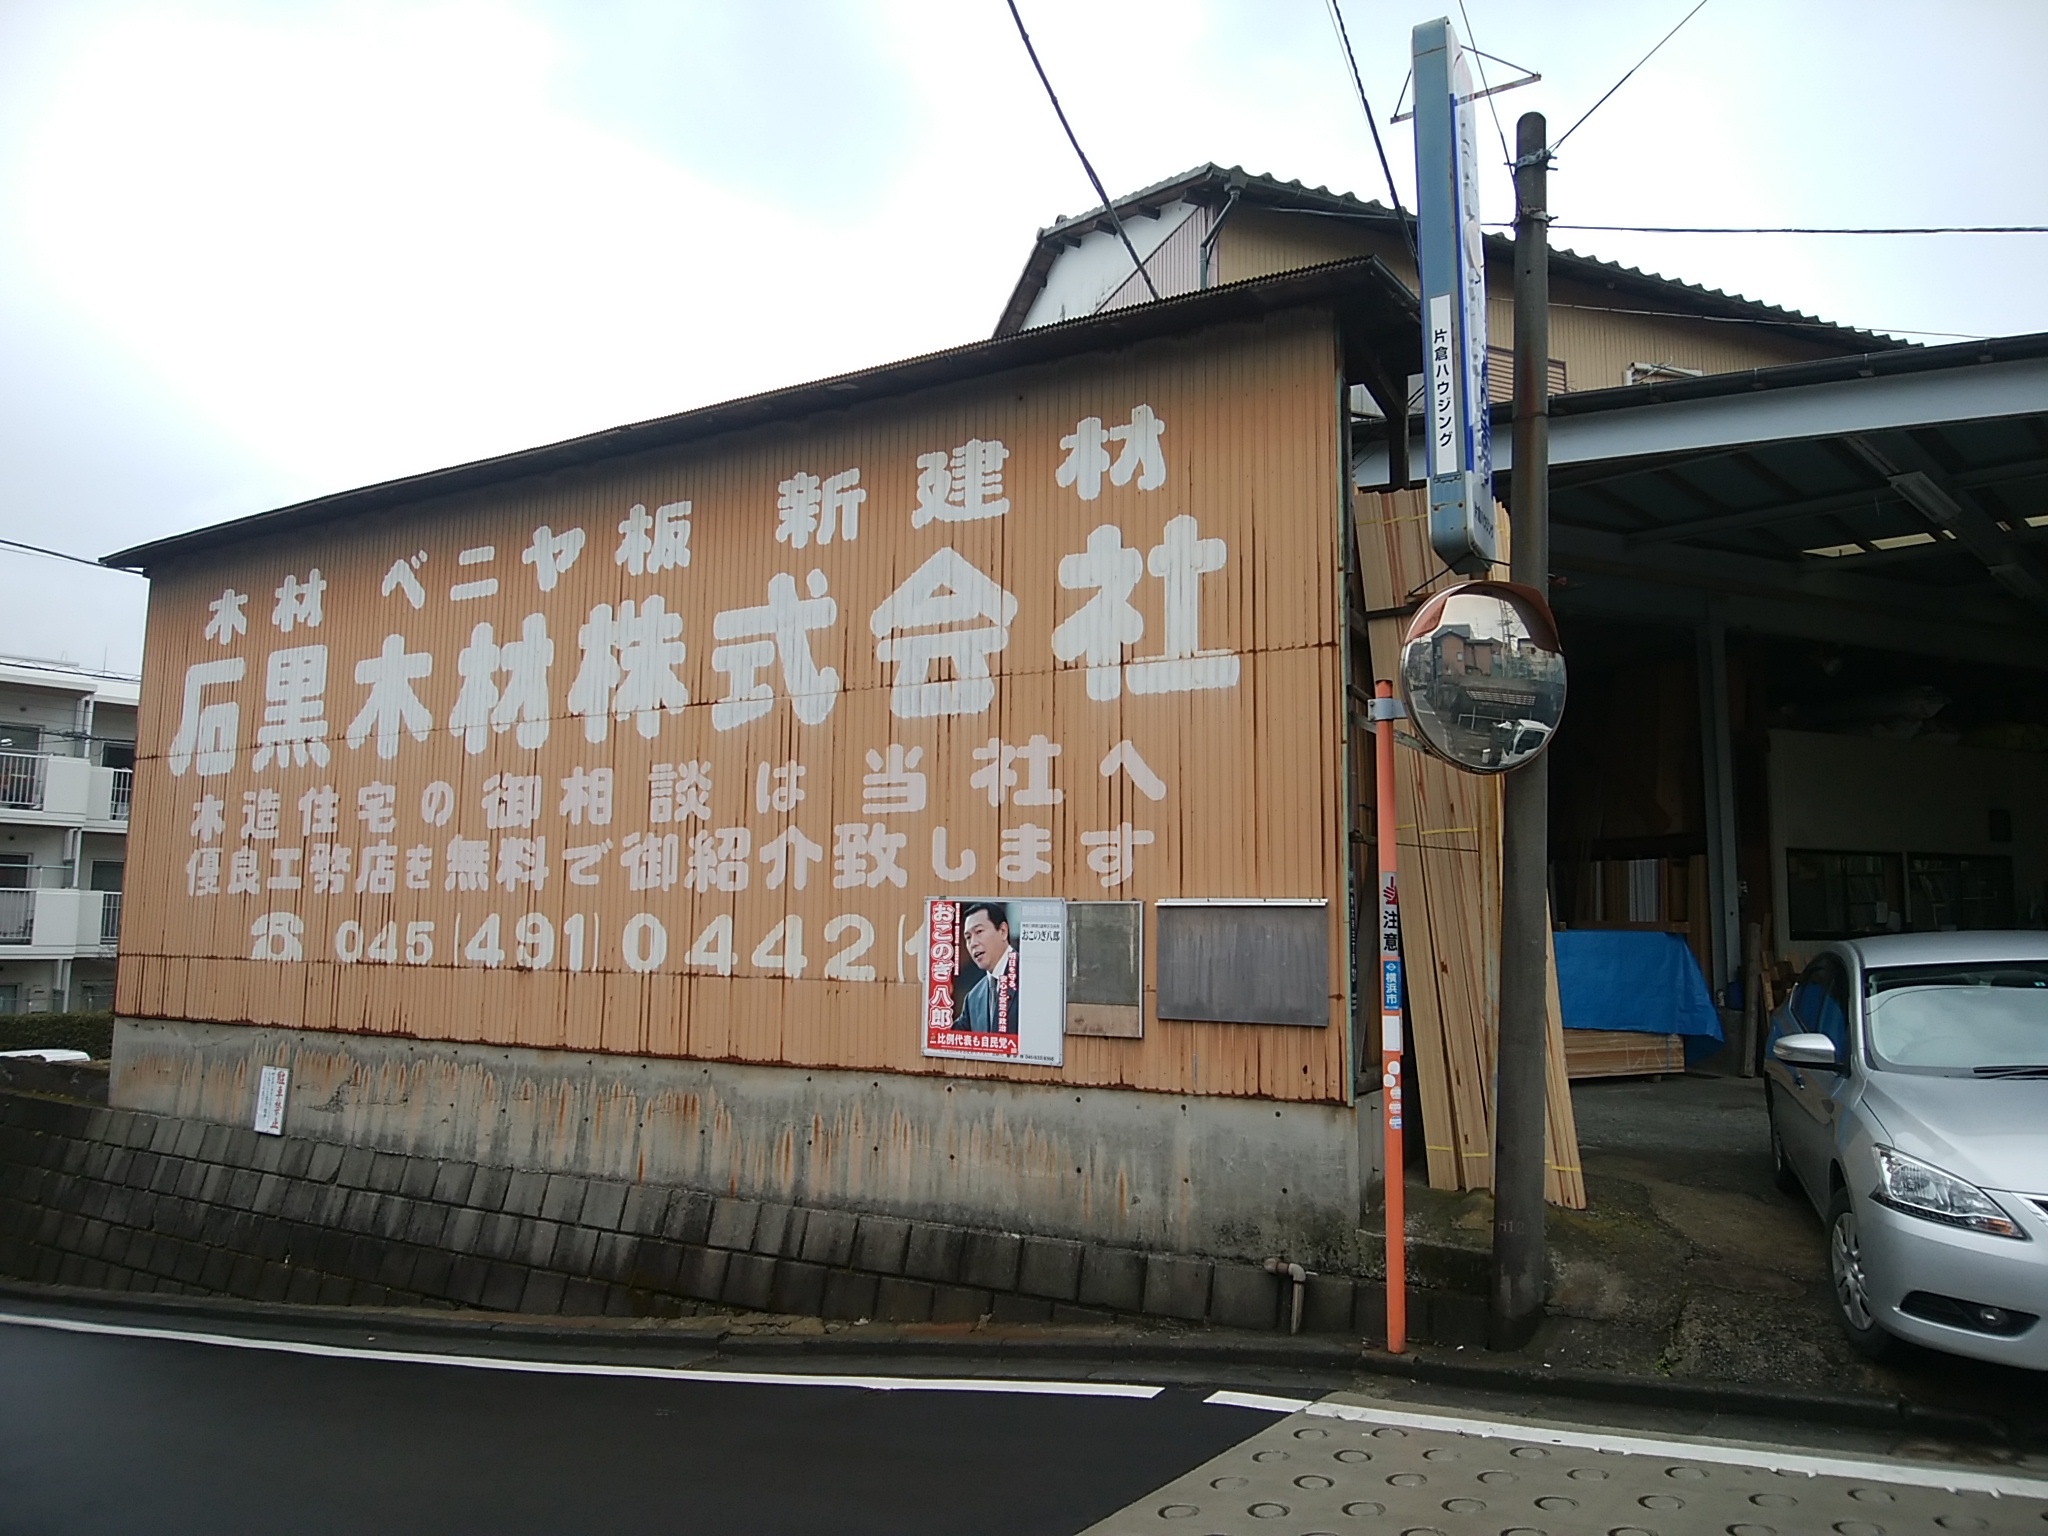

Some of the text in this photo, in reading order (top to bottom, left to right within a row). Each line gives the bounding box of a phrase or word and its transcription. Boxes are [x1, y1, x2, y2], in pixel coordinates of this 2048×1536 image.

[1433, 328, 1453, 447] 片倉ハウジング
[205, 404, 1166, 645] 木材 ベニヤ板 新建材
[169, 514, 1240, 776] 石黒木材株式会社
[190, 734, 1166, 843] 木造住宅の御相談は当社へ
[186, 822, 1155, 896] 優良工務店を無料で御紹介致します
[930, 903, 955, 1029] おこのぎ八郎
[1021, 930, 1061, 942] おこのぎ八郎
[1383, 911, 1398, 951] 注意
[1385, 973, 1398, 1004] 横浜市
[937, 1033, 1017, 1049] 比例代表も自民党へ
